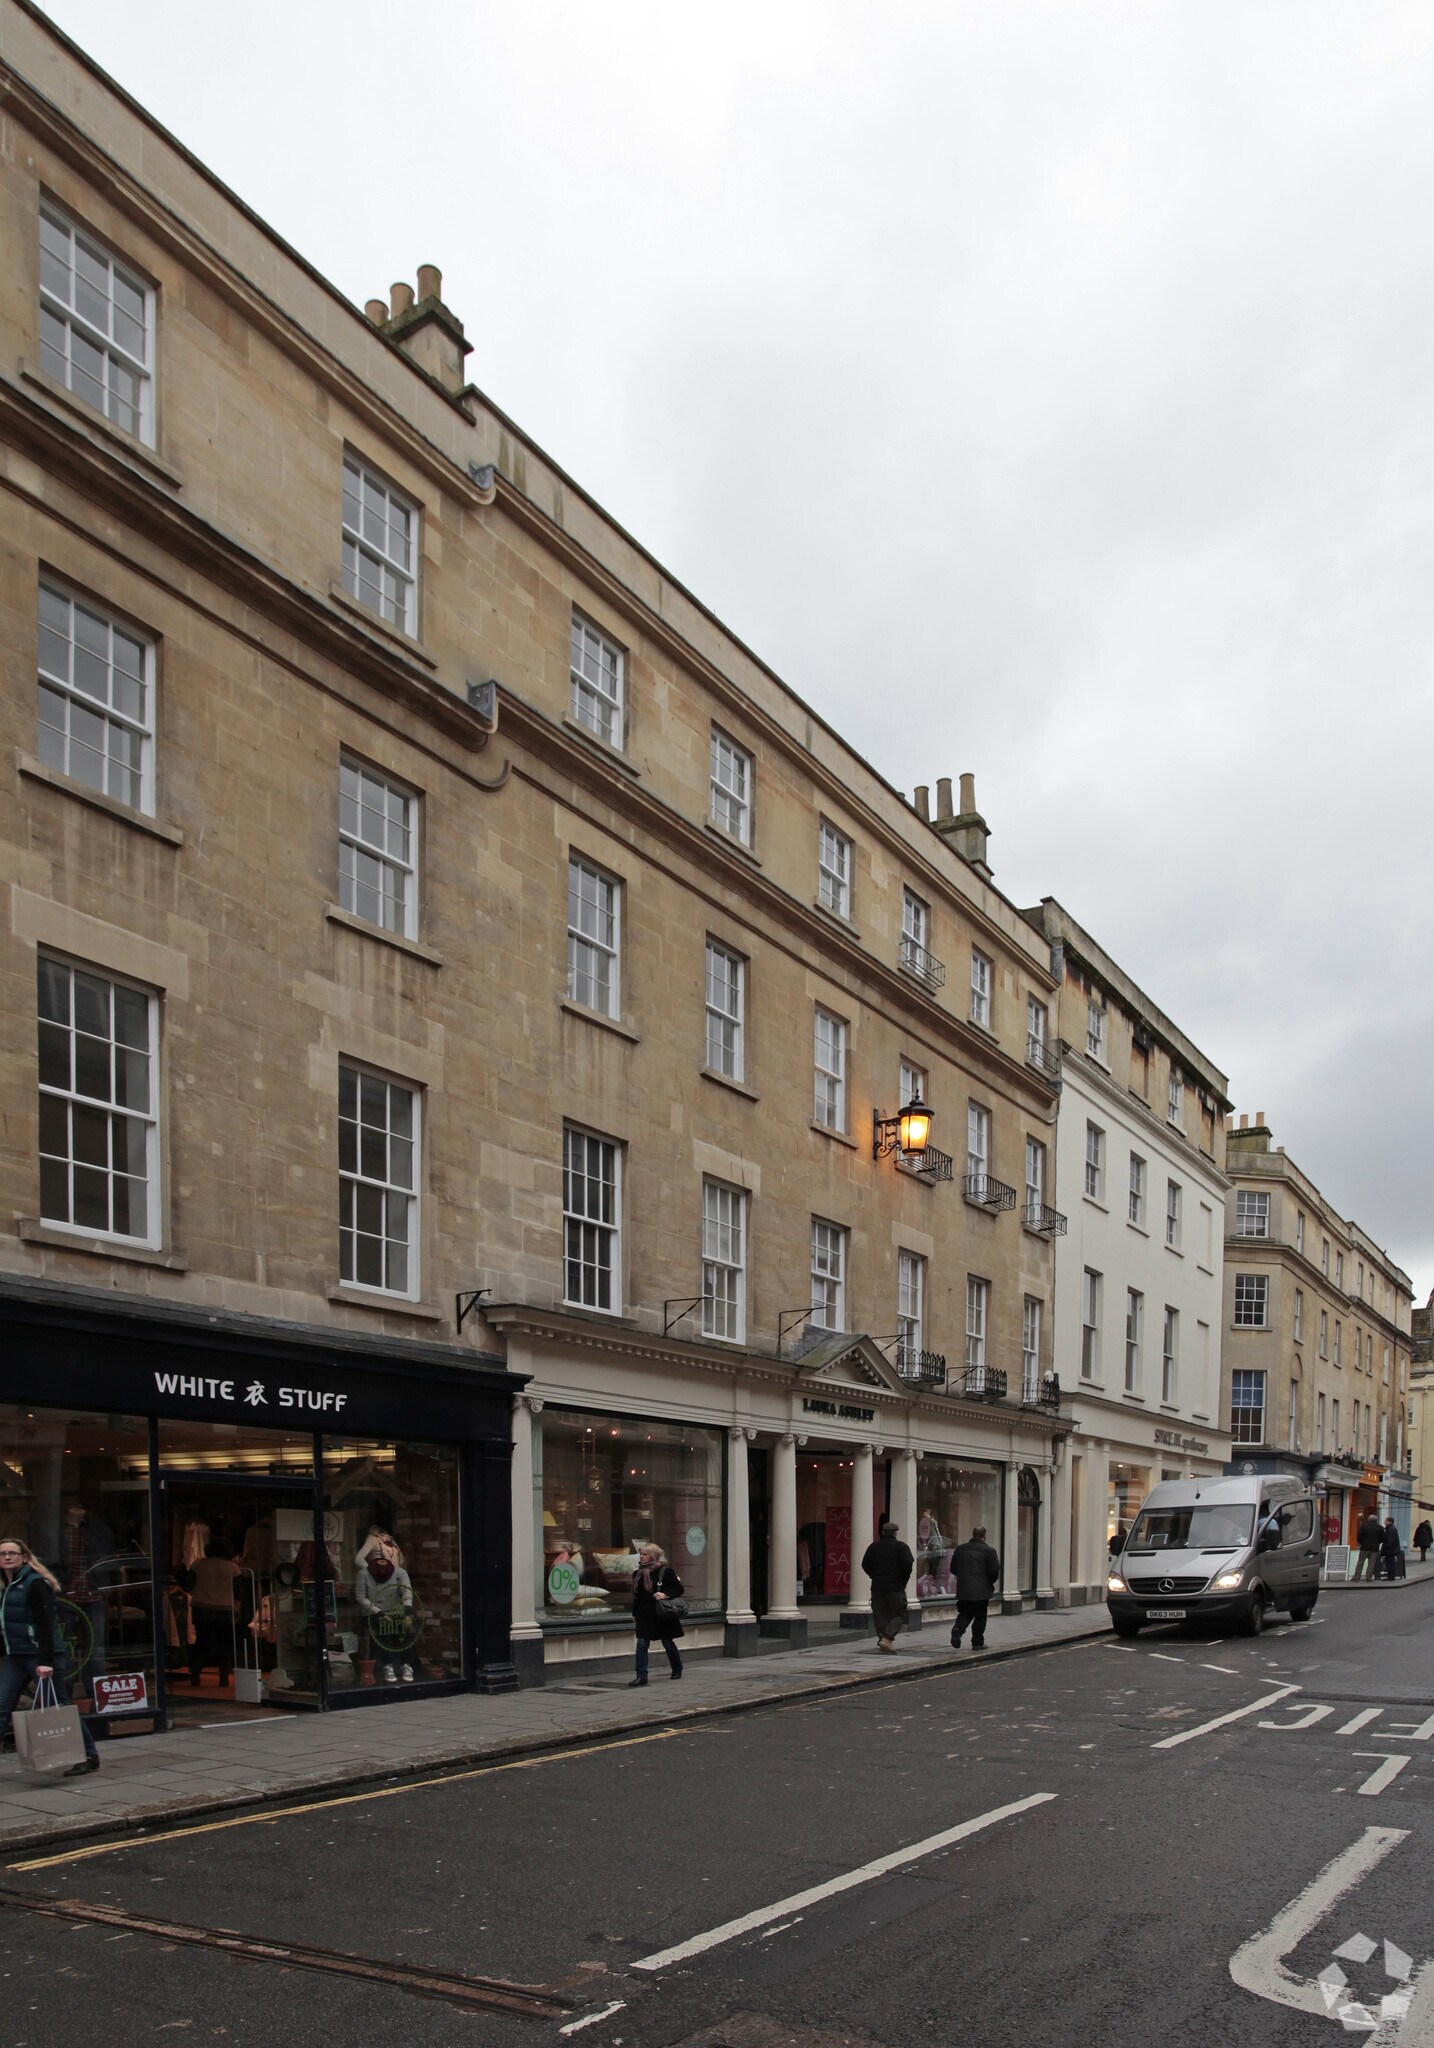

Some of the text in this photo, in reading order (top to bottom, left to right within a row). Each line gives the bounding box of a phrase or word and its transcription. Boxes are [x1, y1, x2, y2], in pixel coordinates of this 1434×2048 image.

[154, 1372, 235, 1401] WHITE
[278, 1387, 348, 1412] STUFF
[830, 1508, 850, 1521] SA
[828, 1552, 850, 1565] SA
[551, 1568, 577, 1591] 0%
[101, 1679, 138, 1693] SALE
